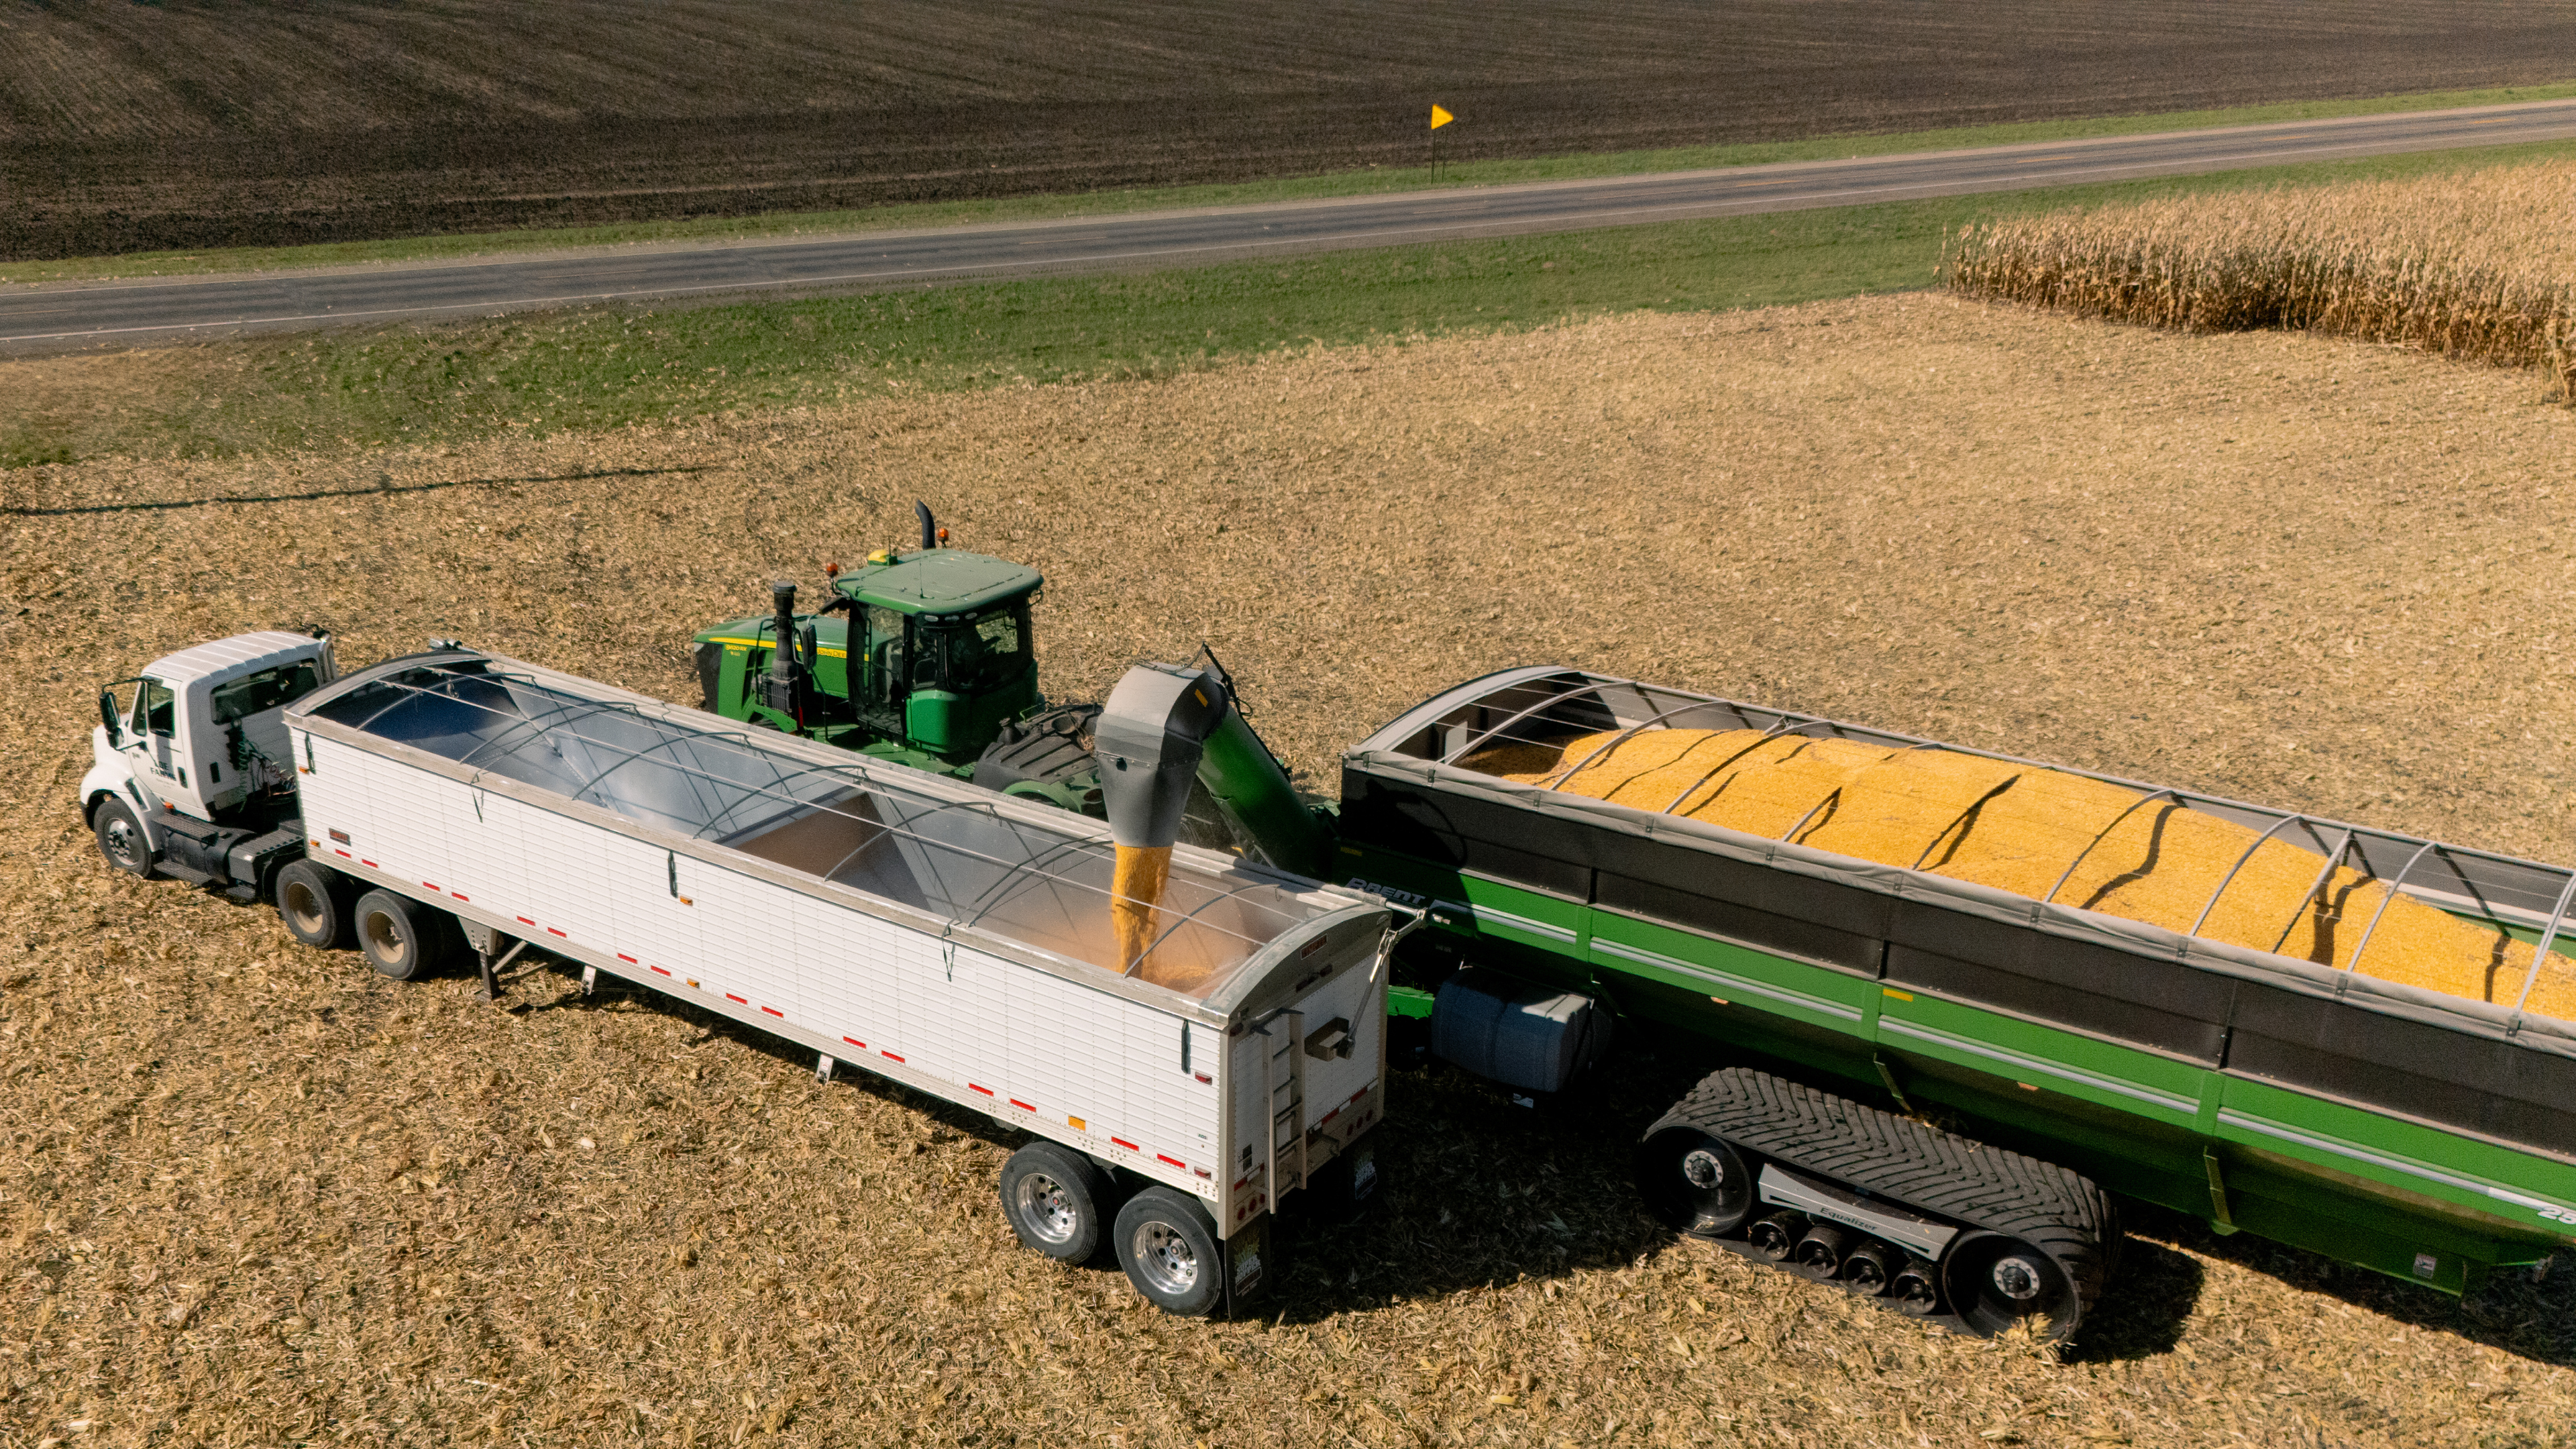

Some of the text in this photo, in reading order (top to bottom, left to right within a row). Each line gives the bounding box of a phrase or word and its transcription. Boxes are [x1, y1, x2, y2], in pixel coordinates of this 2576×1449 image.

[150, 767, 176, 782] FARMS
[1345, 877, 1426, 905] BRENT
[1821, 1207, 1877, 1230] Equalizer
